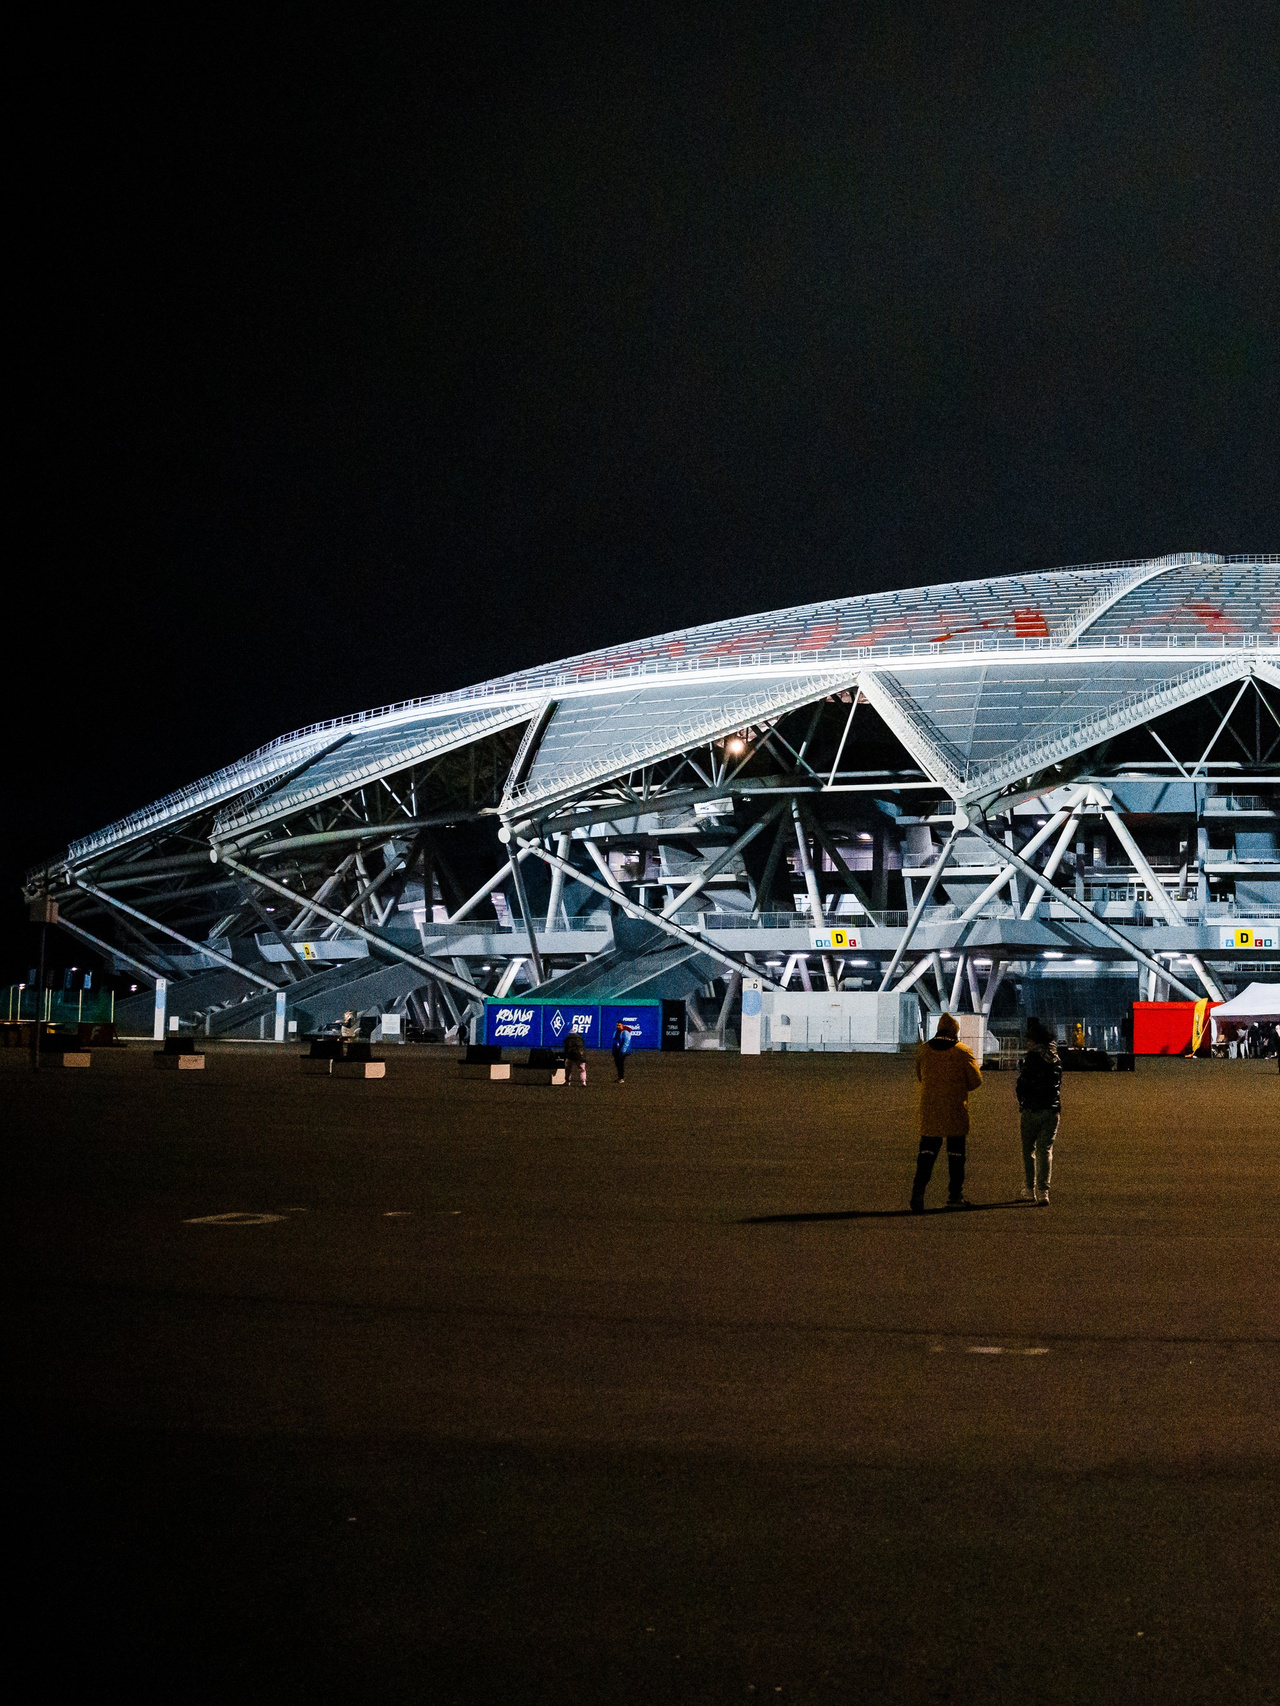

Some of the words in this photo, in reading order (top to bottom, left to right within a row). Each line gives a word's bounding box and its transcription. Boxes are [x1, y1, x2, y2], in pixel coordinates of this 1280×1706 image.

[835, 933, 844, 944] D
[1240, 933, 1249, 943] D
[496, 1008, 535, 1024] КРЫЛЬЯ
[572, 1015, 592, 1024] FON
[494, 1023, 531, 1038] СОВЕТОВ
[572, 1024, 591, 1034] BET
